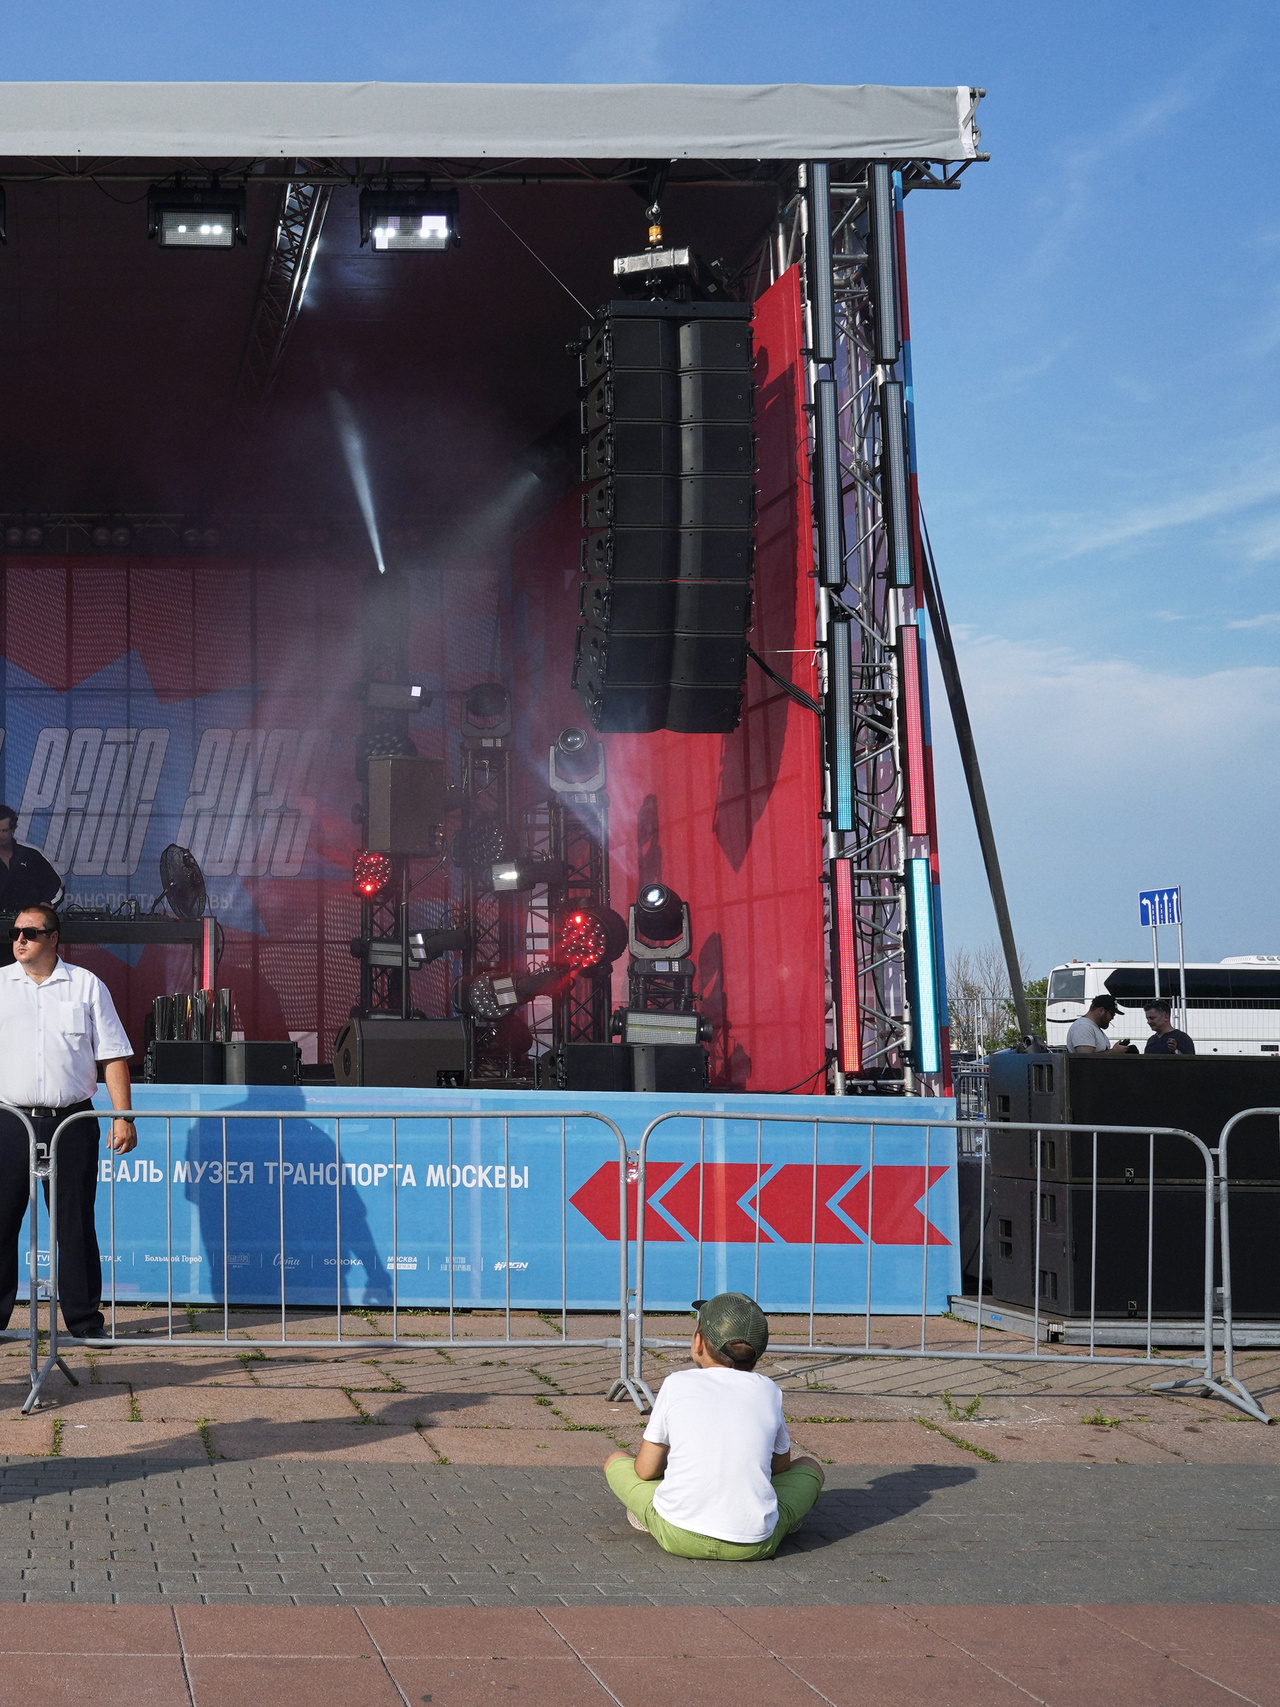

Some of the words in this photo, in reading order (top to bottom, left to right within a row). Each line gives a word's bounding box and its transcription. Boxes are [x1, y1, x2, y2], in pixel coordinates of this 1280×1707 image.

[13, 726, 171, 877] РЕЙС
[175, 727, 333, 878] 2025
[64, 893, 156, 908] РАНСПОТА
[173, 1160, 254, 1185] МУЗЕЯ
[263, 1161, 417, 1188] ТРАНСПОРТА
[425, 1164, 529, 1189] МОСКВЫ
[144, 1254, 180, 1262] Большой
[181, 1255, 203, 1264] Город
[323, 1258, 364, 1266] SOROKA
